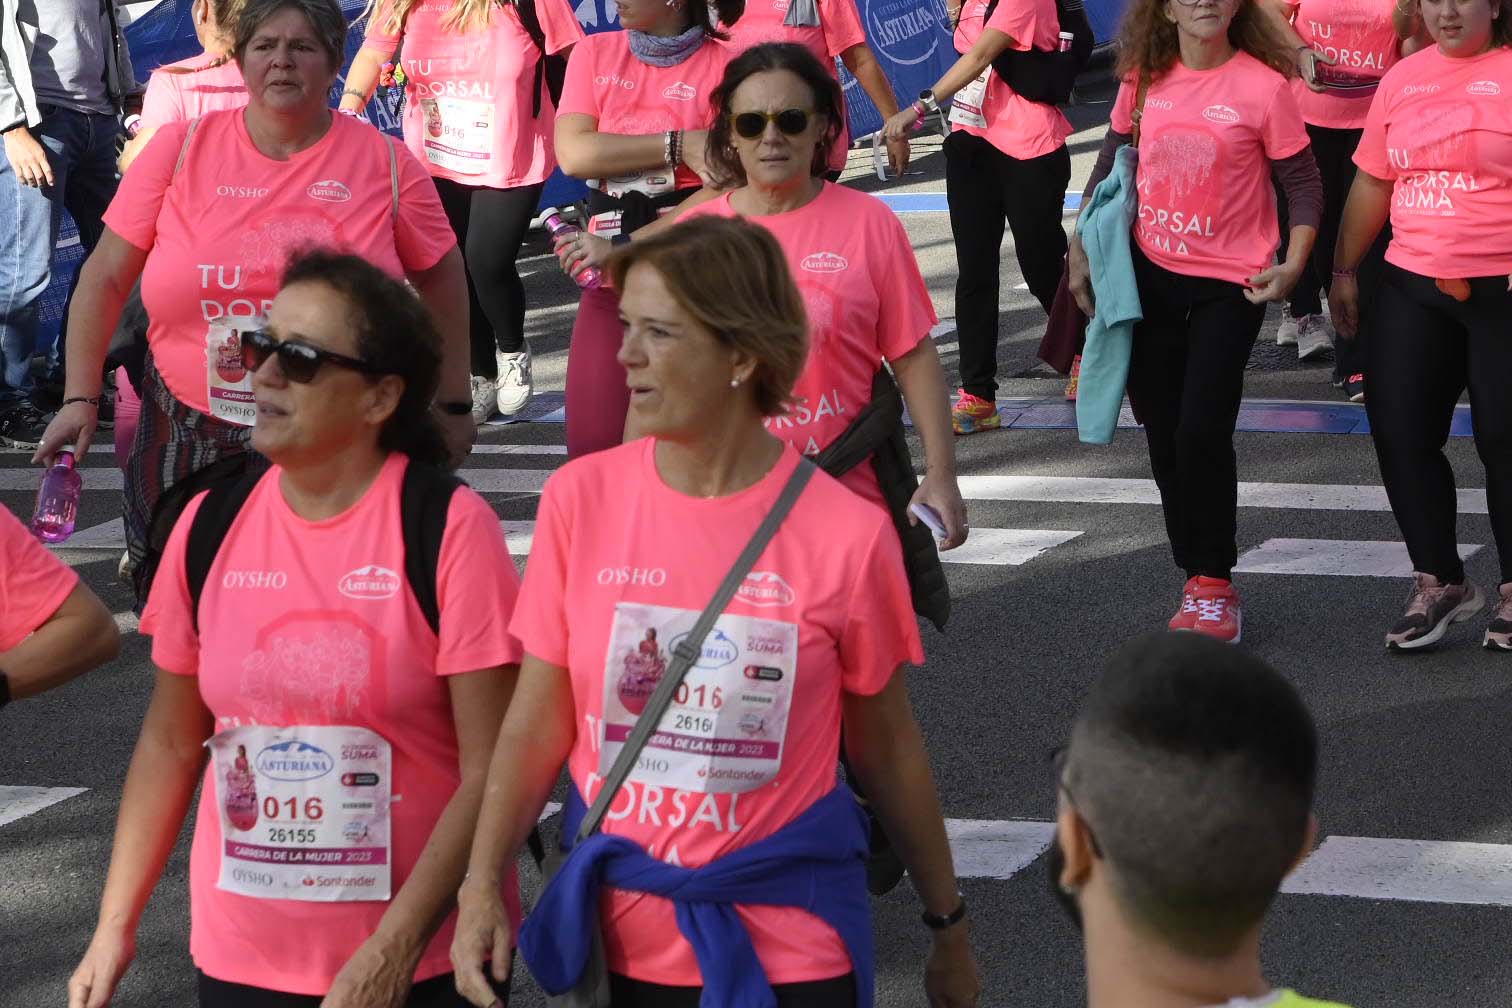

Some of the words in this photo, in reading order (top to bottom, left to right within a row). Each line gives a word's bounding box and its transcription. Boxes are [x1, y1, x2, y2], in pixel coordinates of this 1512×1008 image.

[1309, 20, 1331, 39] TU
[408, 59, 432, 76] TU
[416, 80, 494, 99] DORSAL
[1388, 148, 1409, 169] TU
[1397, 188, 1454, 209] SUMA
[197, 264, 241, 289] TU
[220, 403, 256, 418] OYSHO
[223, 571, 287, 590] OYSHO
[598, 568, 667, 586] OYSHO
[674, 680, 722, 709] 016
[260, 757, 328, 772] ASTURIANA
[341, 750, 379, 761] SUMA
[709, 767, 765, 781] Santander
[262, 796, 324, 820] 016
[269, 828, 316, 843] 26155
[234, 845, 271, 861] CARRERA
[272, 849, 286, 861] DE
[289, 850, 302, 862] LA
[305, 851, 342, 863] MUJER
[346, 852, 372, 862] 2023
[233, 867, 273, 887] OYSHO
[316, 875, 376, 887] Santander
